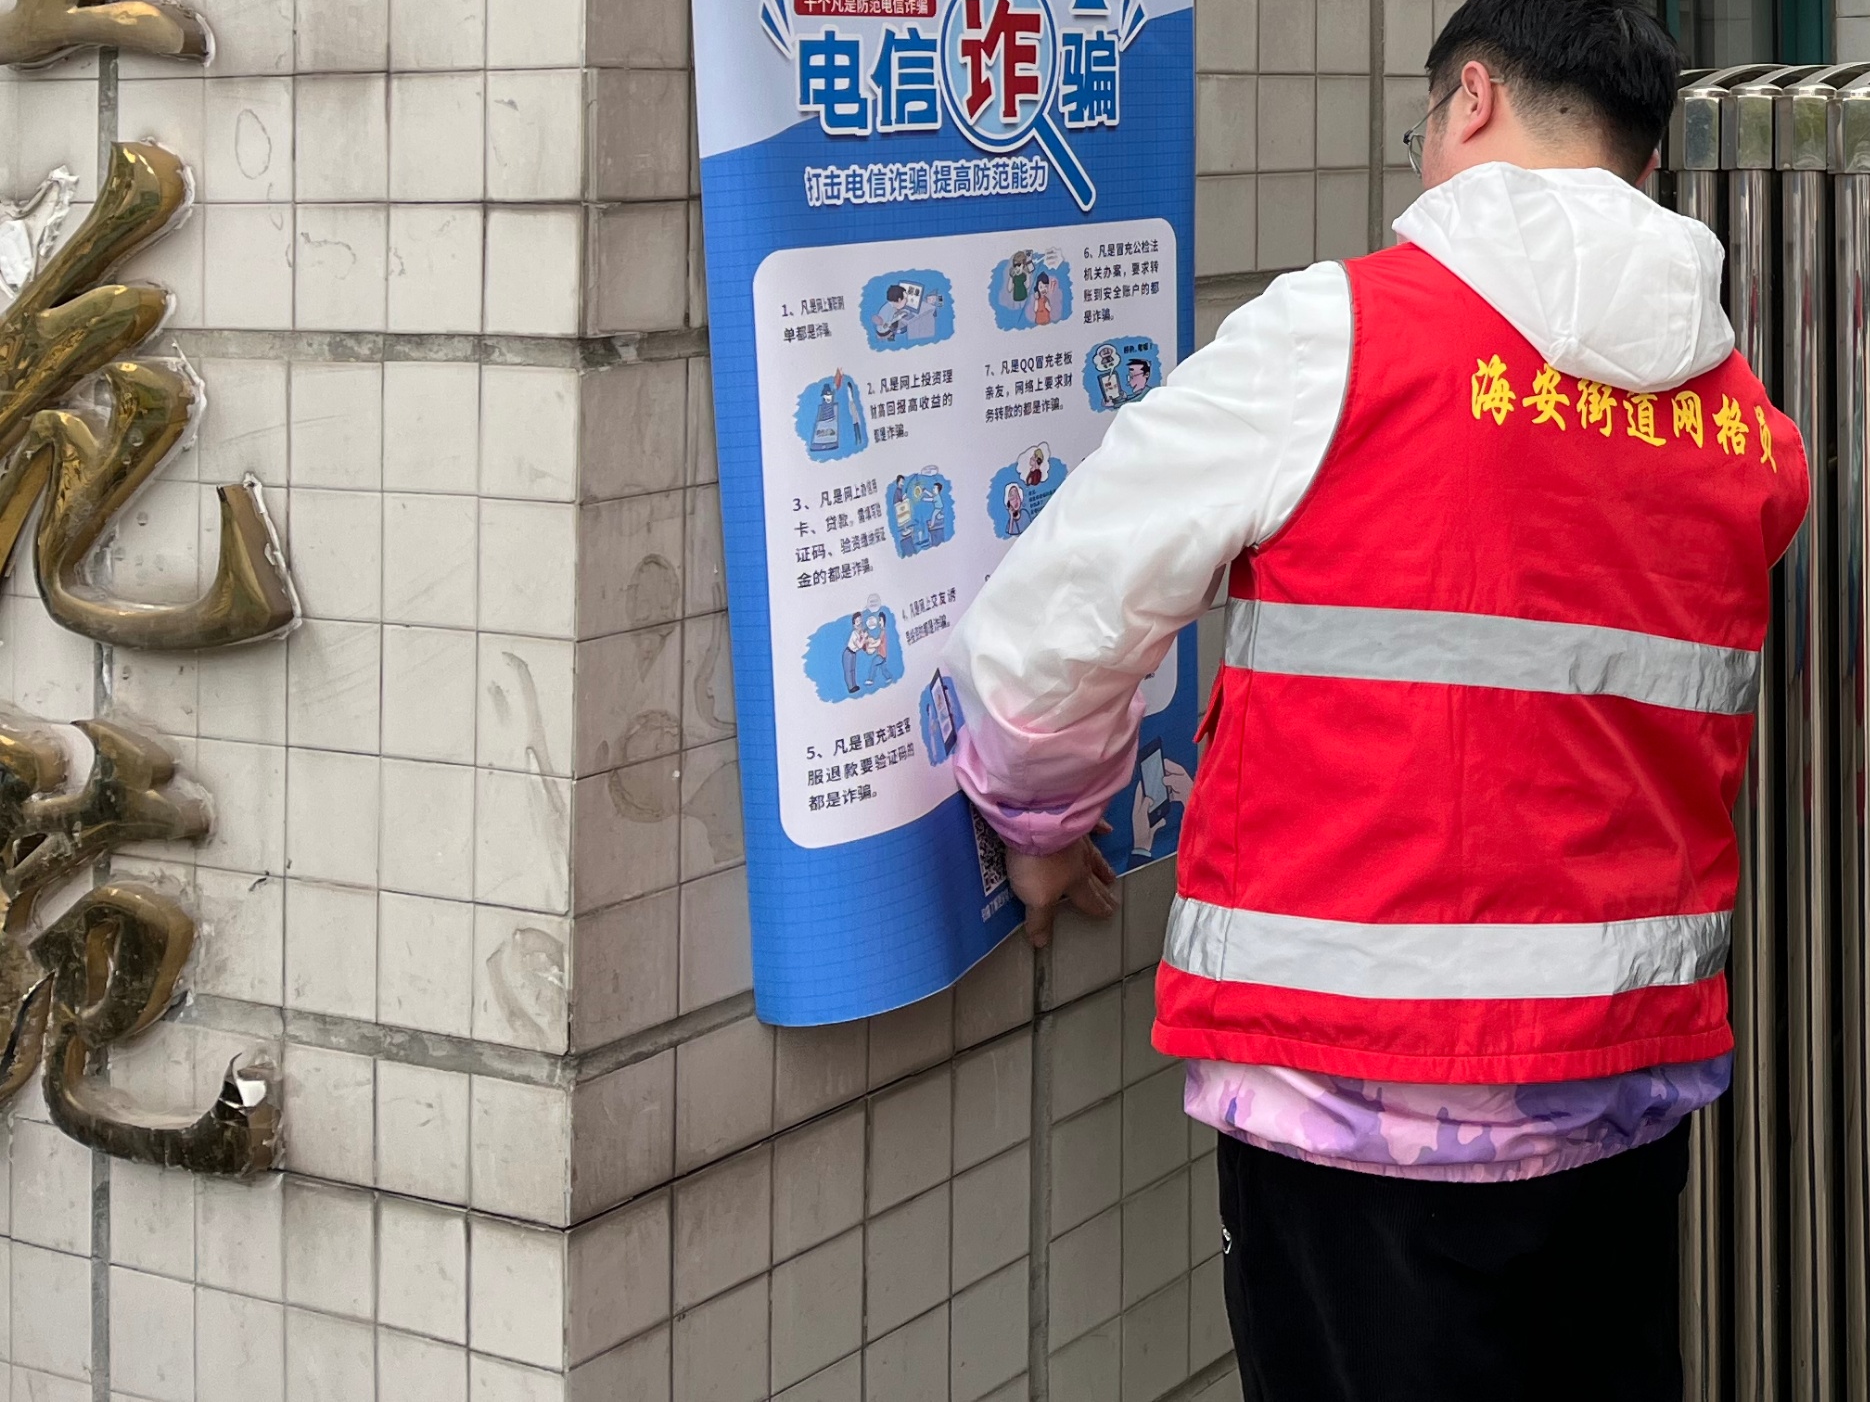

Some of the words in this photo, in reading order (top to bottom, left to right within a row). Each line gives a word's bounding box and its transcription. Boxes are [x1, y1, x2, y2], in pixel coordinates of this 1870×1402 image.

[806, 165, 928, 204] 打击电信诈骗
[932, 157, 1048, 196] 提高防范能力
[1083, 239, 1159, 259] 6、凡是冒充公检法
[1083, 260, 1159, 281] 机关办案，要求转
[1083, 281, 1160, 302] 账到安全账户的都
[985, 351, 1073, 377] 7、凡是QQ冒充老板
[985, 372, 1073, 400] 亲友，网络上要求财
[870, 392, 953, 419] 财高回报高收益的
[806, 717, 911, 760] 5、凡是冒充淘宝客
[807, 742, 914, 786] 服退款要验证码的
[808, 784, 877, 811] 都是诈骗。
